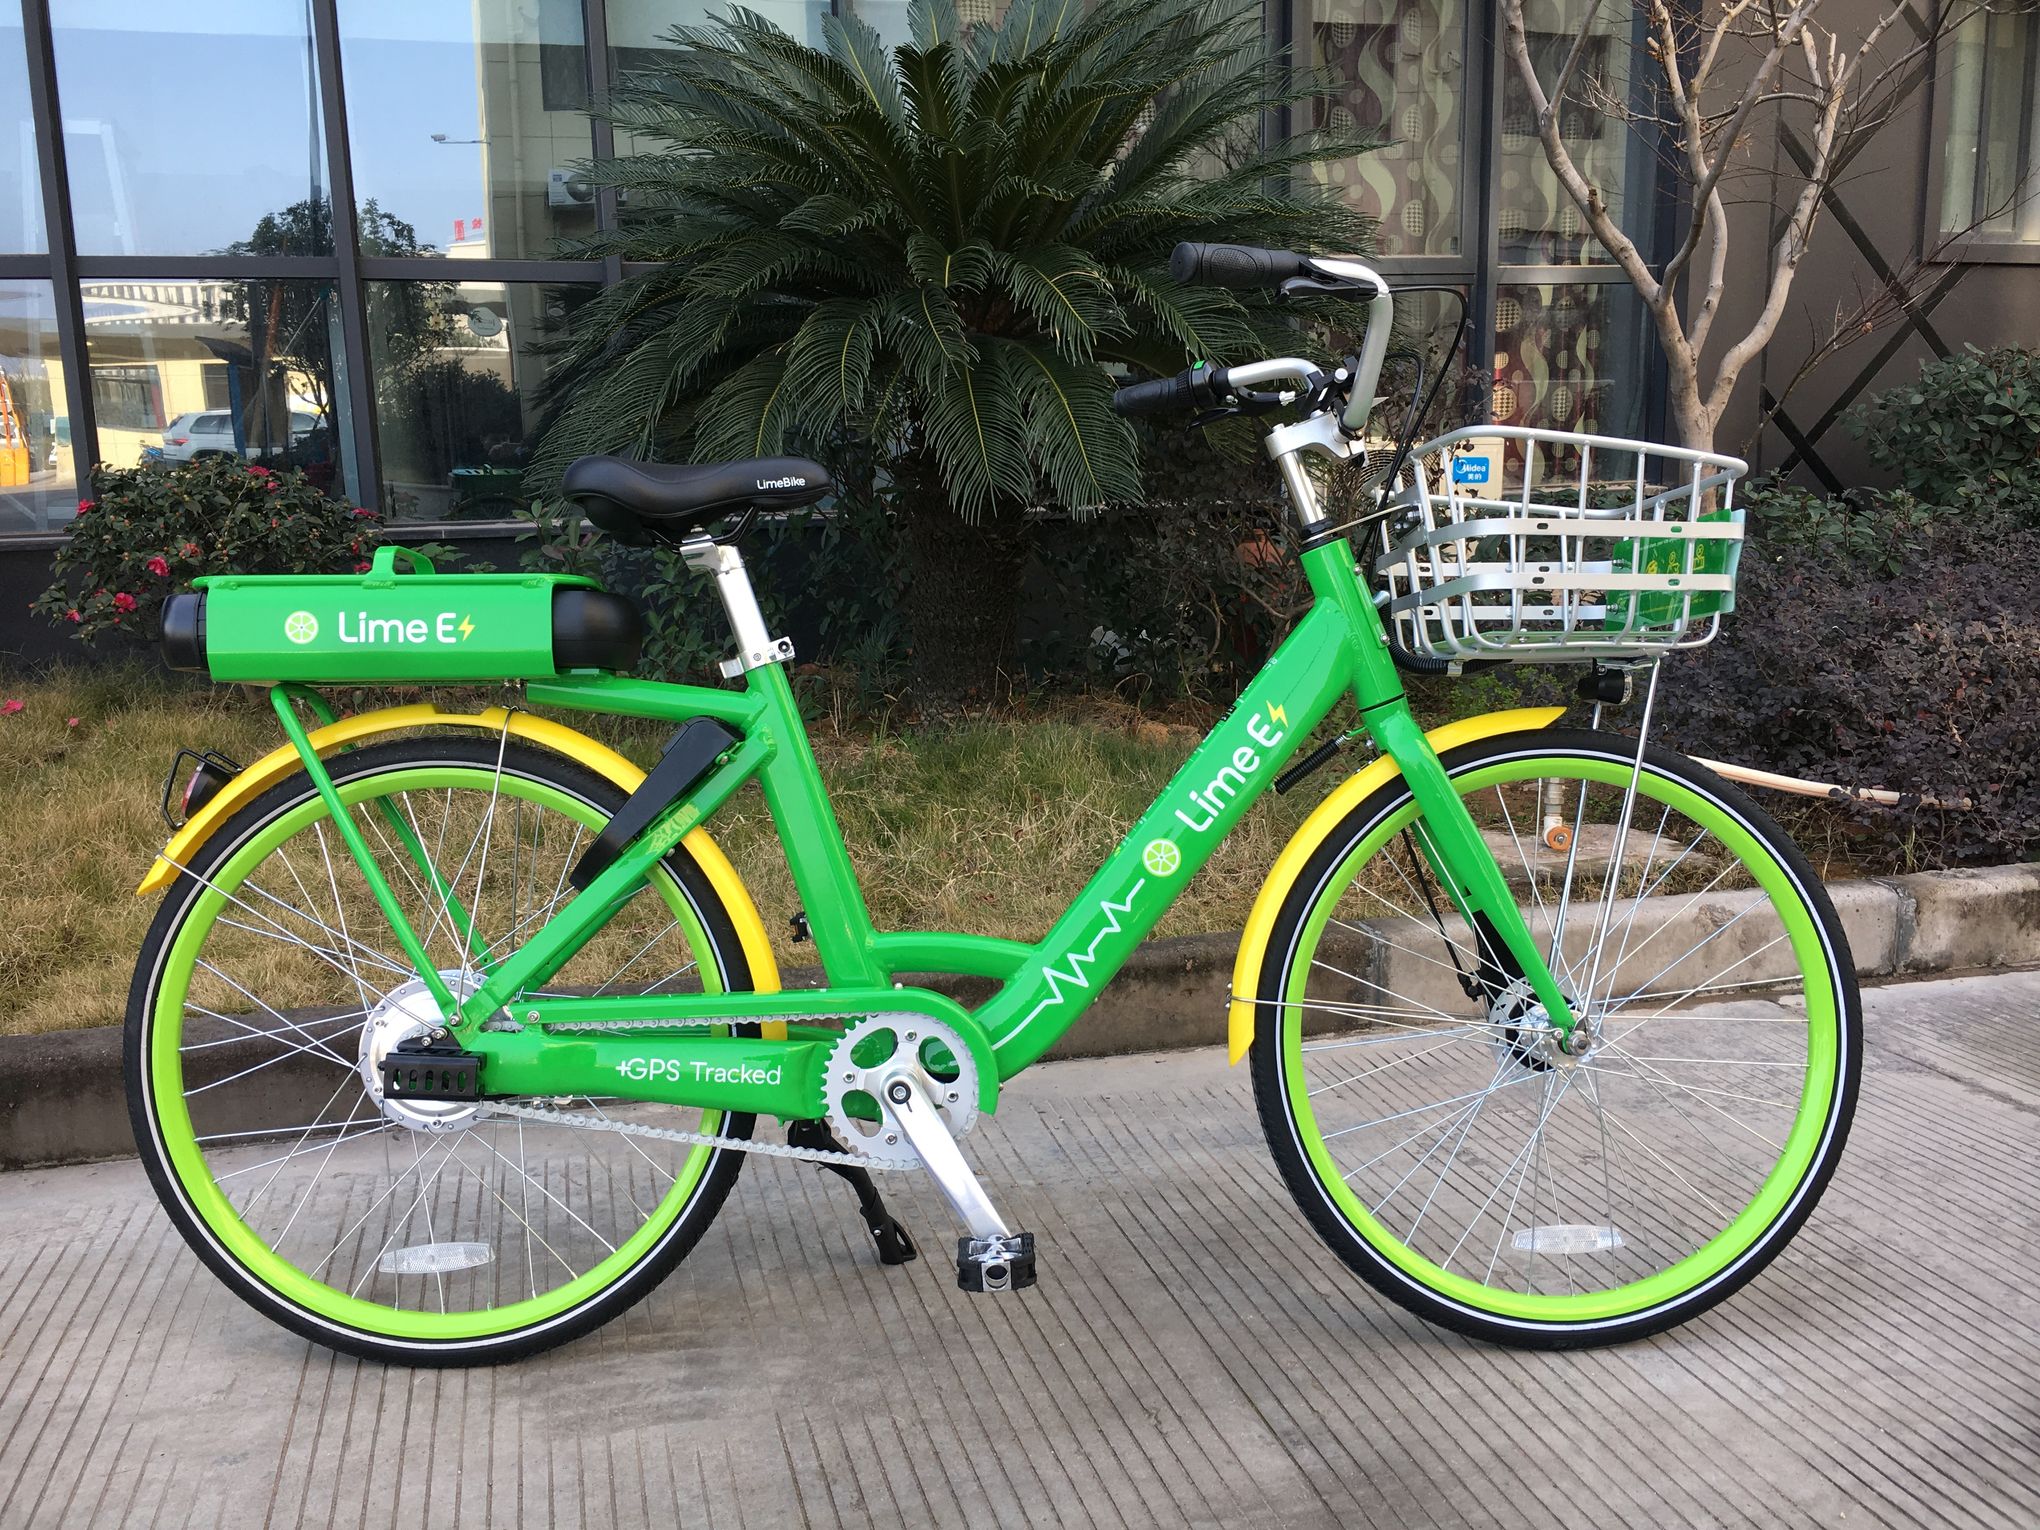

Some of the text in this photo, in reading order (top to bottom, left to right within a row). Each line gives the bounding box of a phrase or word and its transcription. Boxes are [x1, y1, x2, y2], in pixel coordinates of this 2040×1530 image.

[1456, 460, 1486, 474] Midea
[756, 476, 806, 490] LimeBike
[338, 611, 457, 644] Lime E
[1174, 712, 1283, 832] Lime E
[689, 1061, 782, 1085] Tracked
